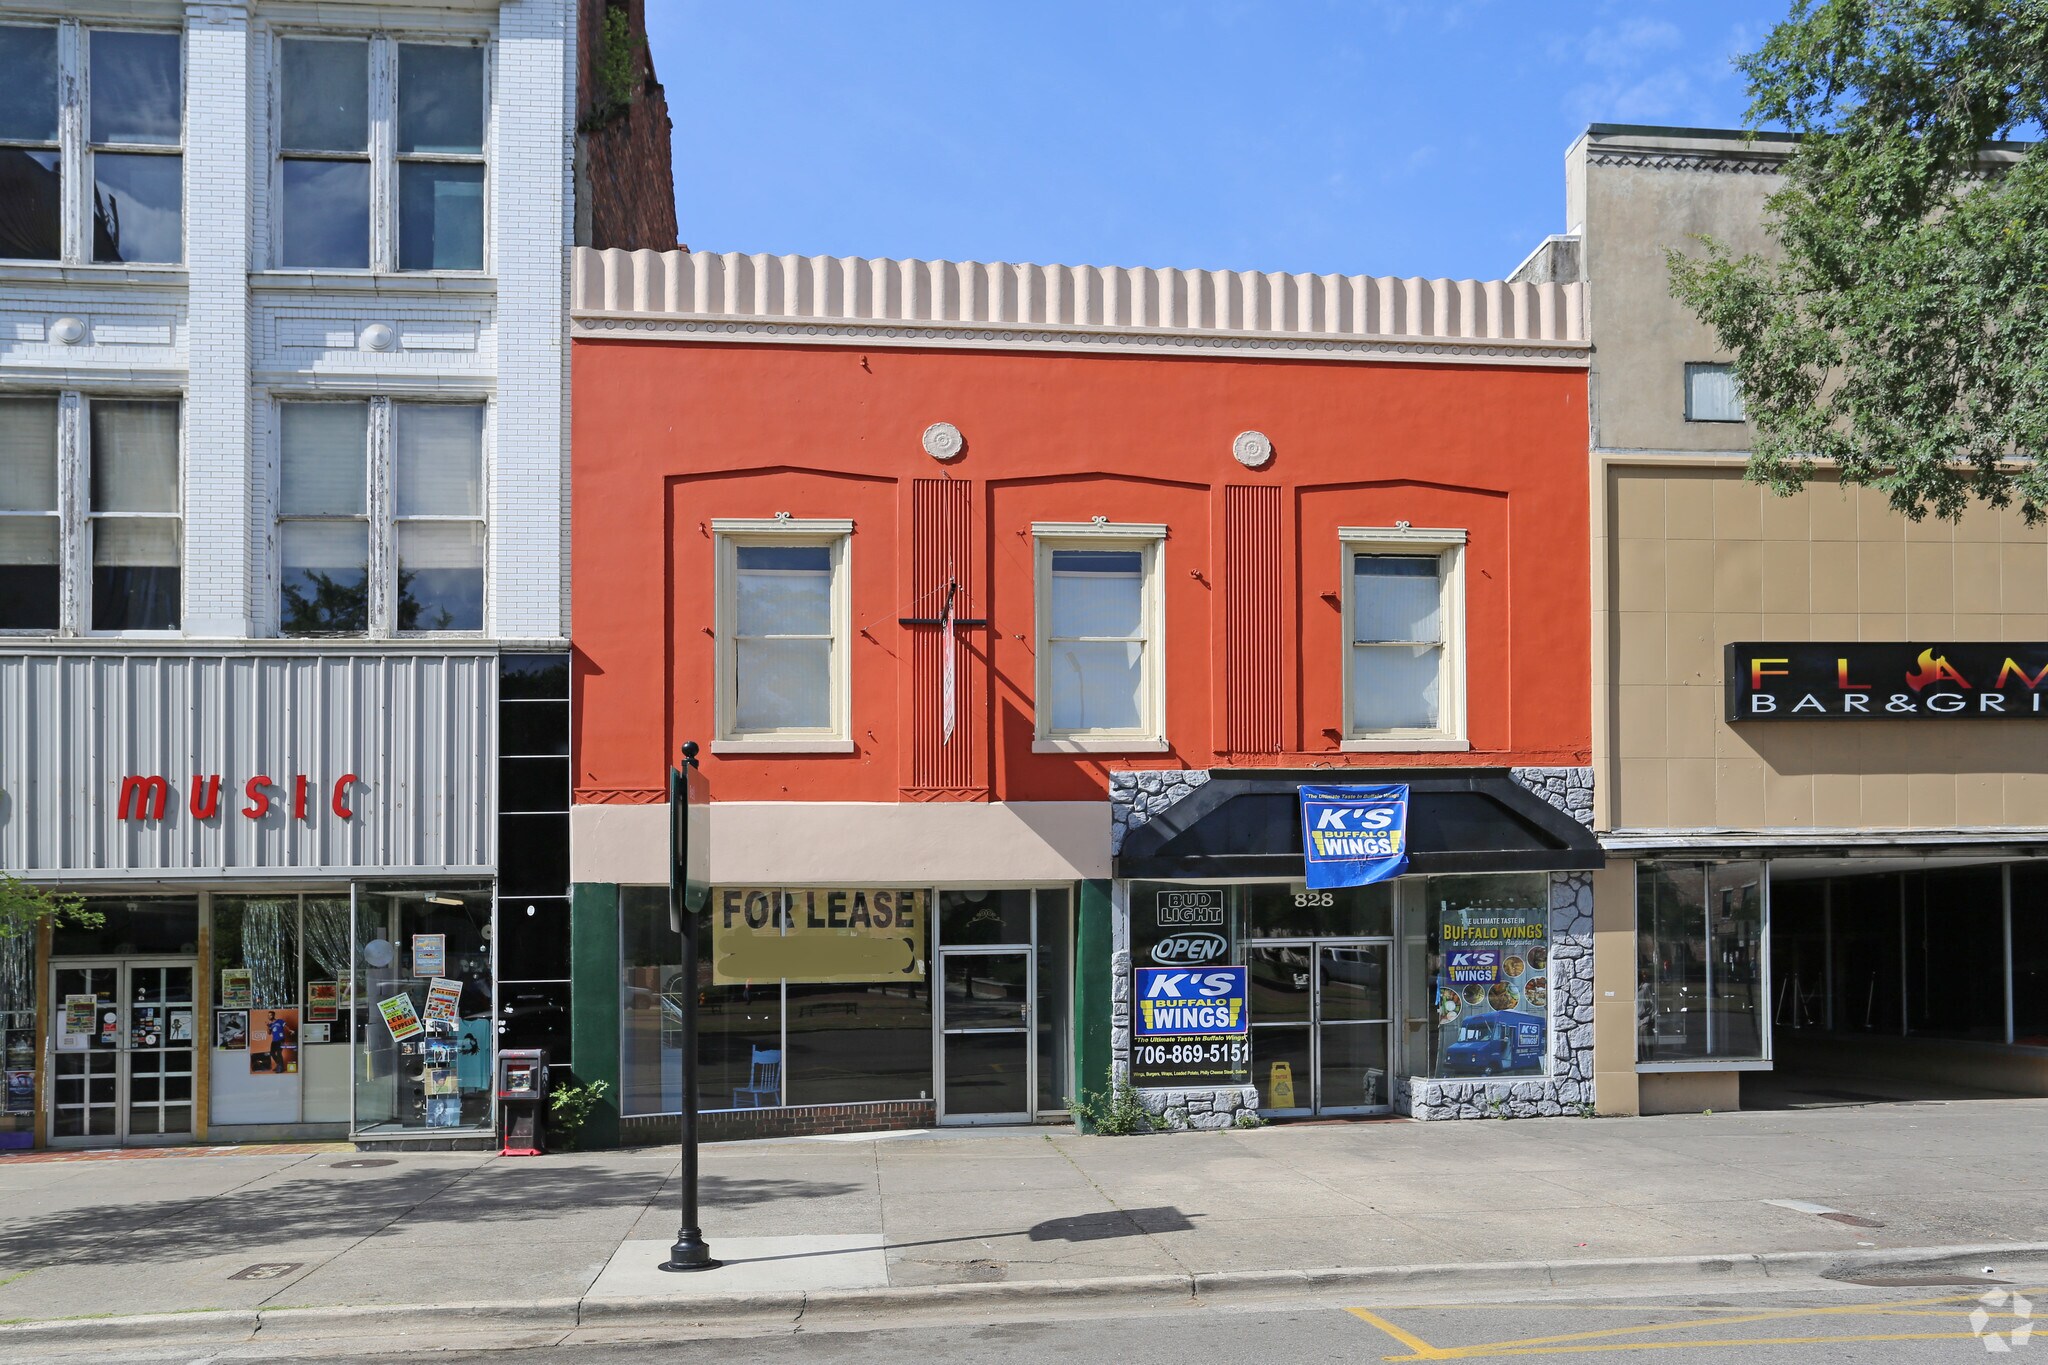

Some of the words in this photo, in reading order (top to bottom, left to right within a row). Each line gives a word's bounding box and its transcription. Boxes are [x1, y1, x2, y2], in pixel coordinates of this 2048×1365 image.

[1316, 808, 1395, 830] K'S
[1324, 830, 1388, 838] BUFFALO
[1323, 838, 1392, 856] WINGS
[1168, 893, 1212, 908] BUD
[1294, 892, 1334, 908] 828
[723, 890, 796, 929] FOR
[806, 890, 915, 929] LEASE
[1161, 907, 1221, 922] LIGHT
[1472, 917, 1500, 925] ULTIMATE
[1443, 924, 1498, 940] BUFFALO
[1502, 923, 1543, 939] WINGS
[1156, 938, 1219, 960] OPEN
[1452, 953, 1495, 966] K'S
[1455, 970, 1492, 982] WINGS
[1147, 973, 1236, 998] K'S
[1155, 998, 1227, 1008] BUFFALO
[386, 1014, 403, 1025] LED
[1153, 1007, 1230, 1029] WINGS
[1134, 1043, 1249, 1064] 706-869-5151
